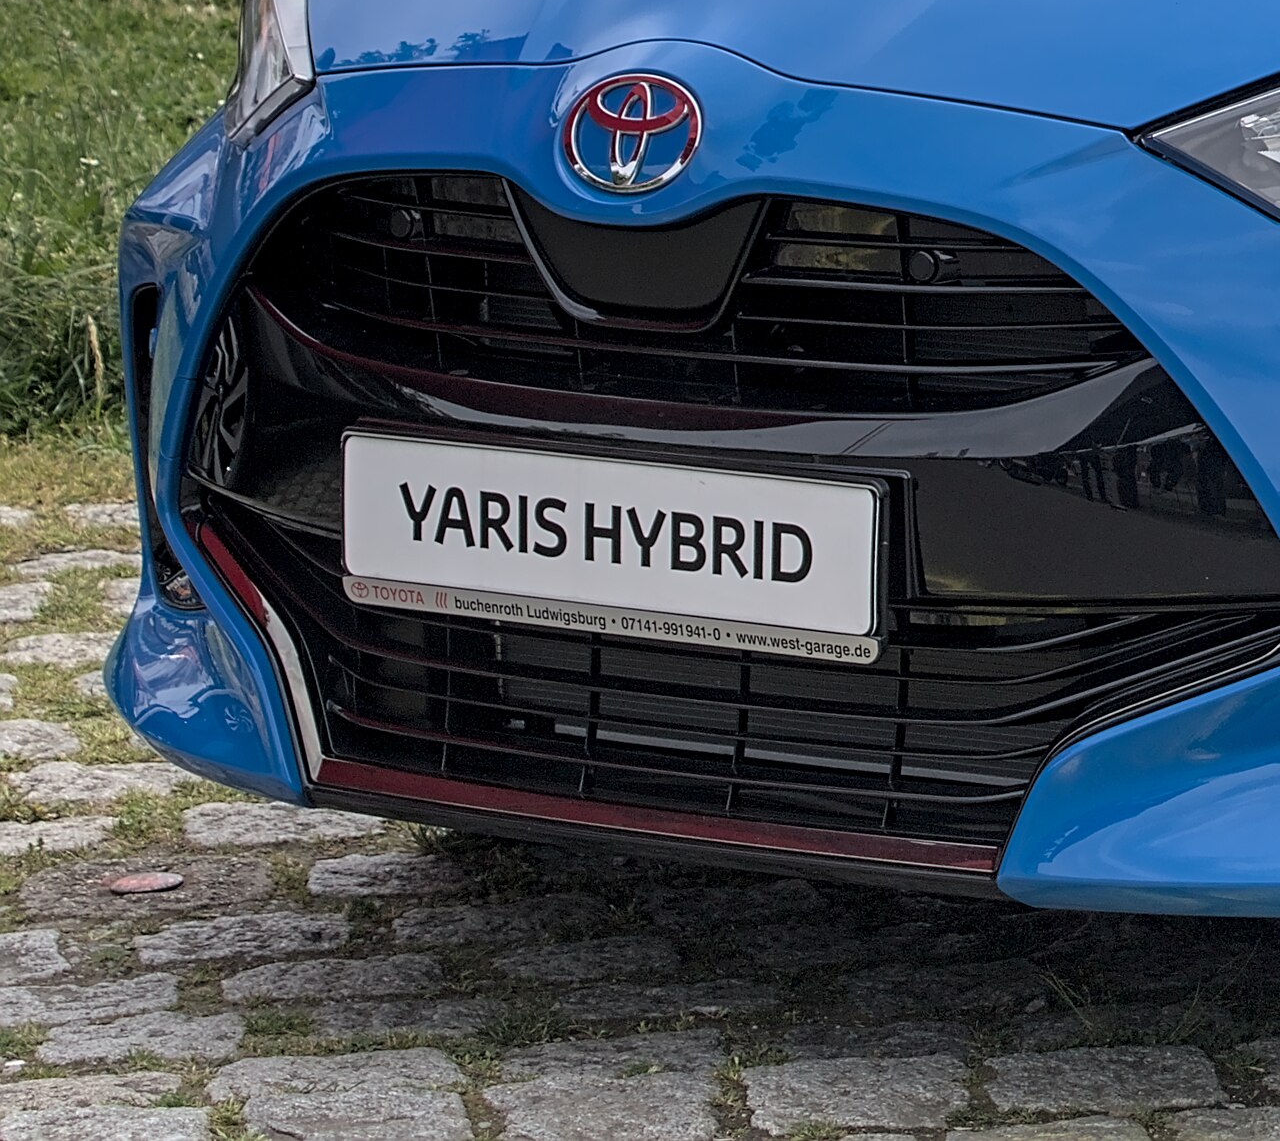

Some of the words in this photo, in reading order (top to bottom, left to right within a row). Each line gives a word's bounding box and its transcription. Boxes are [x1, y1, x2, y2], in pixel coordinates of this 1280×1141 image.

[399, 481, 567, 558] YARIS
[584, 502, 813, 584] HYBRID
[372, 585, 424, 605] TOYOTA
[454, 596, 523, 618] buchenroth
[527, 605, 606, 630] Ludwigsburg
[621, 616, 721, 641] 07141-991941-0
[736, 631, 871, 659] www.west-garage.de
